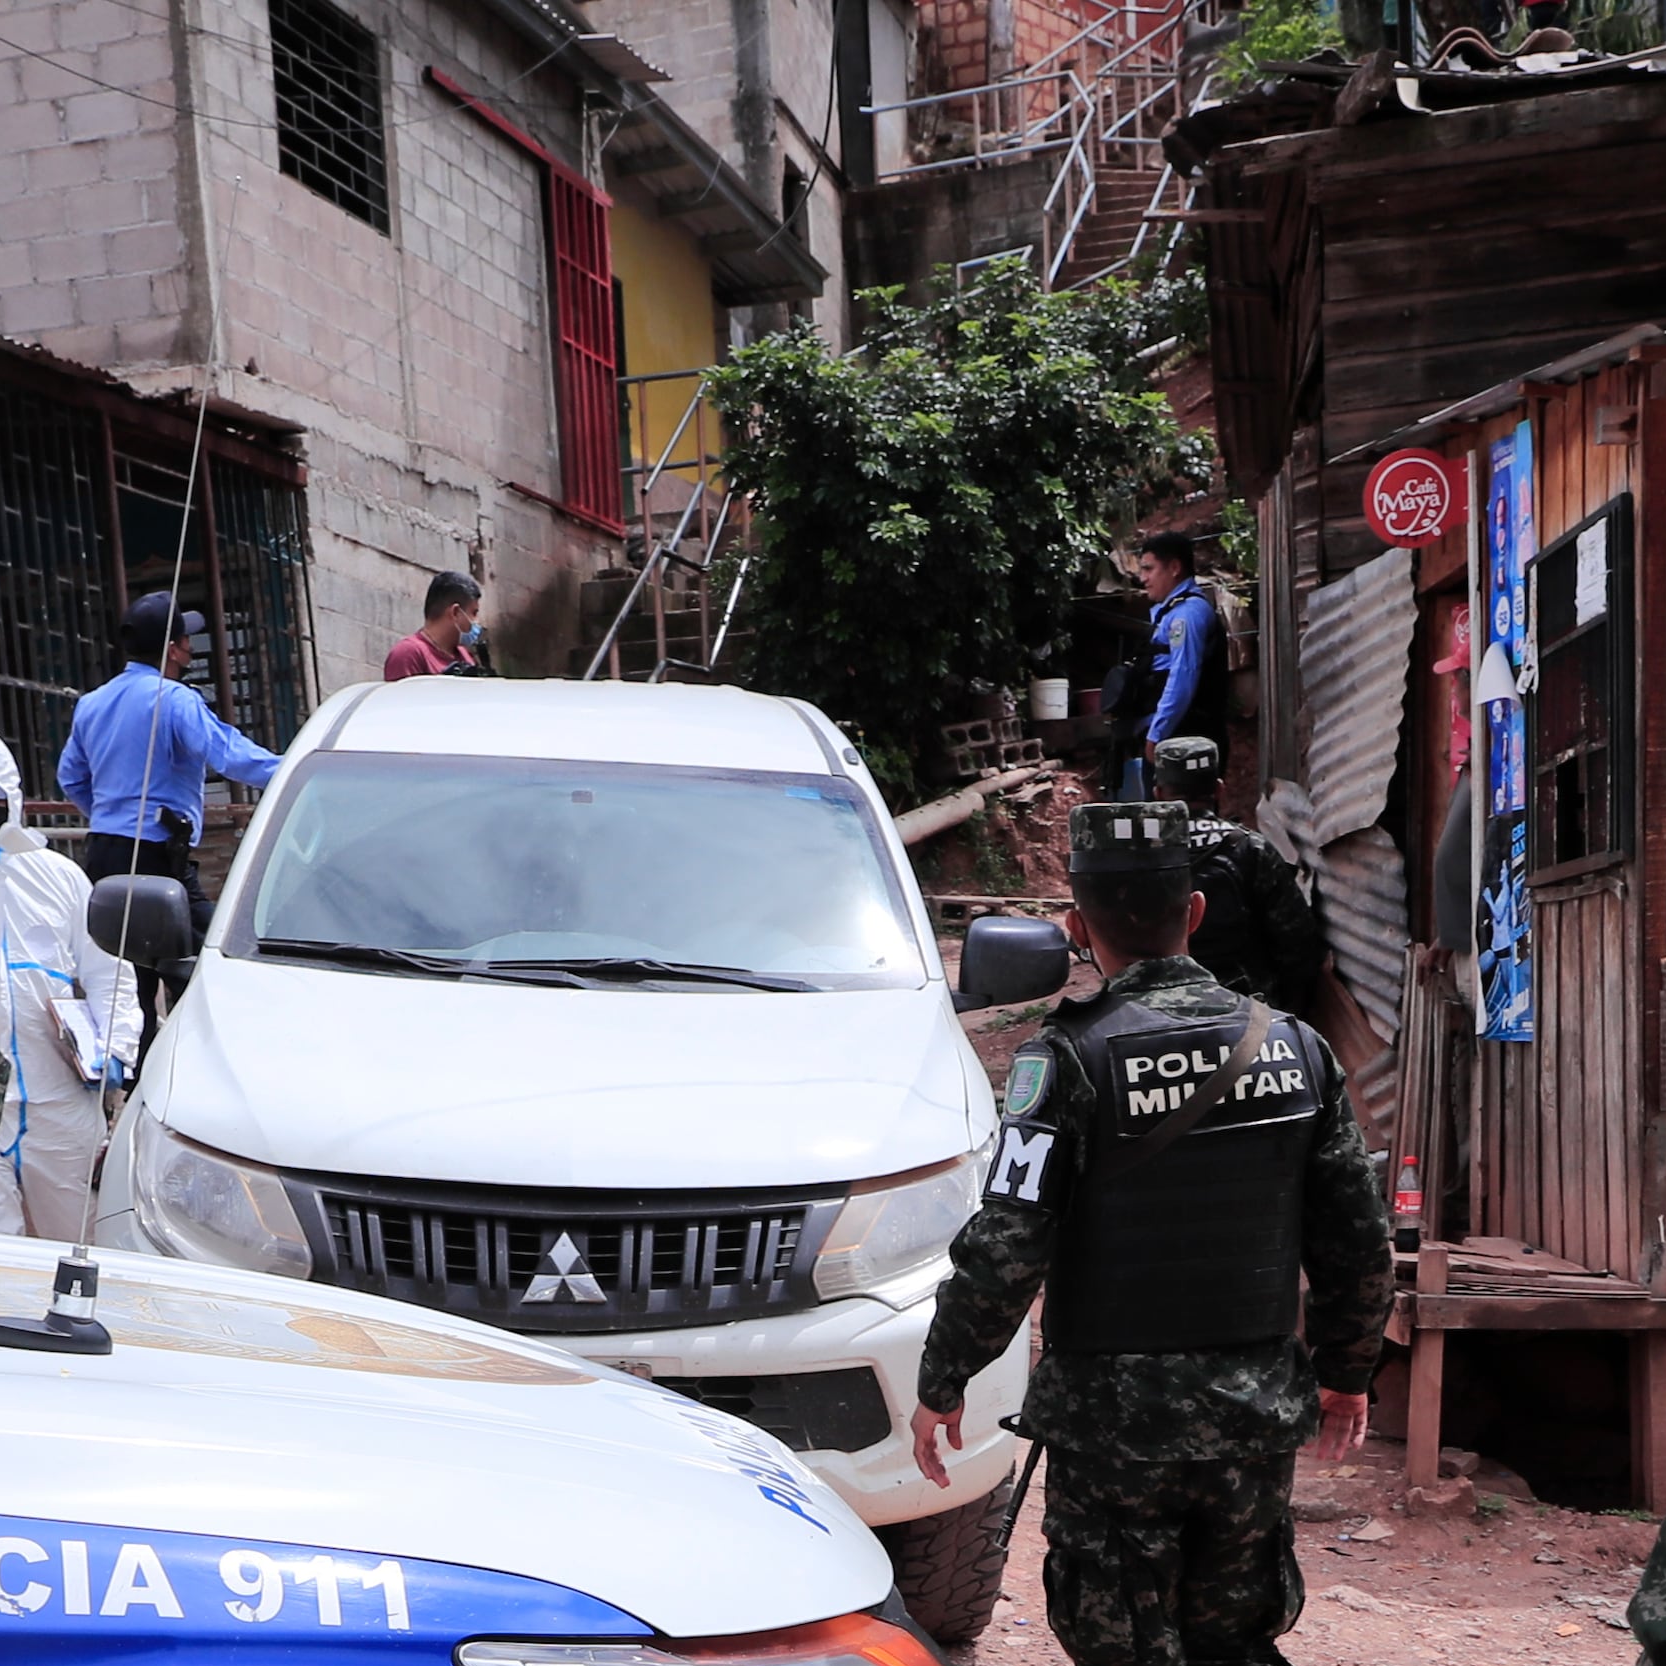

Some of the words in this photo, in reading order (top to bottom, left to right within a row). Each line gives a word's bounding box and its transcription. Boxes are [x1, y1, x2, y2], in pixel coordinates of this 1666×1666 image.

[1188, 819, 1235, 833] ICIA
[1125, 1039, 1297, 1084] POLIIA
[1128, 1068, 1306, 1117] MITAR
[989, 1127, 1055, 1203] M
[218, 1549, 411, 1631] 911
